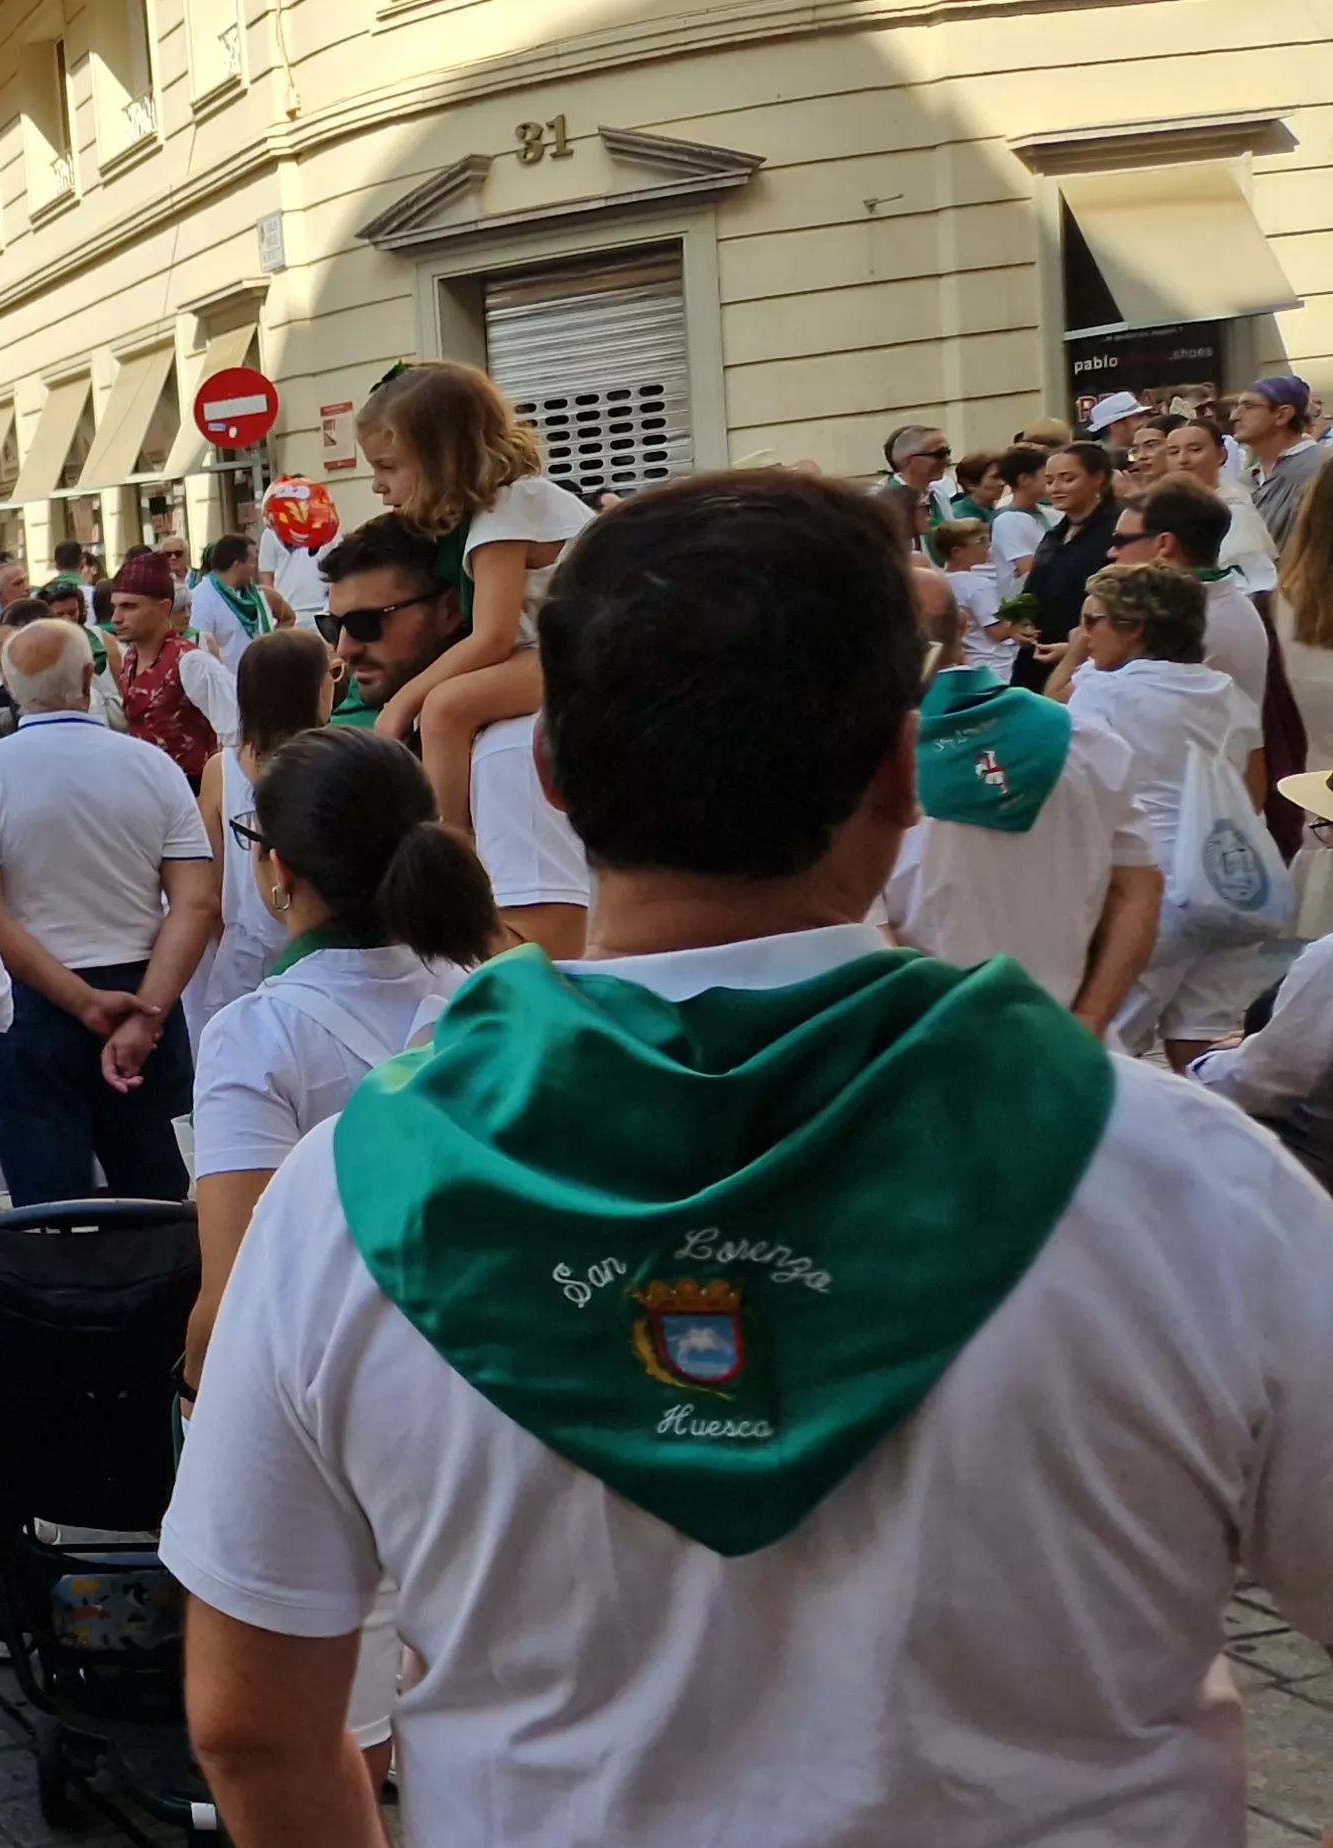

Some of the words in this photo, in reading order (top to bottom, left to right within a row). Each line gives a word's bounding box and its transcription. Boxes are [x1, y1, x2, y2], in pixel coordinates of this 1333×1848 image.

[515, 114, 574, 165] 31
[1074, 355, 1118, 375] pablo
[552, 1256, 626, 1309] San
[673, 1227, 833, 1293] Lorenzo
[656, 1403, 774, 1438] Huesca
